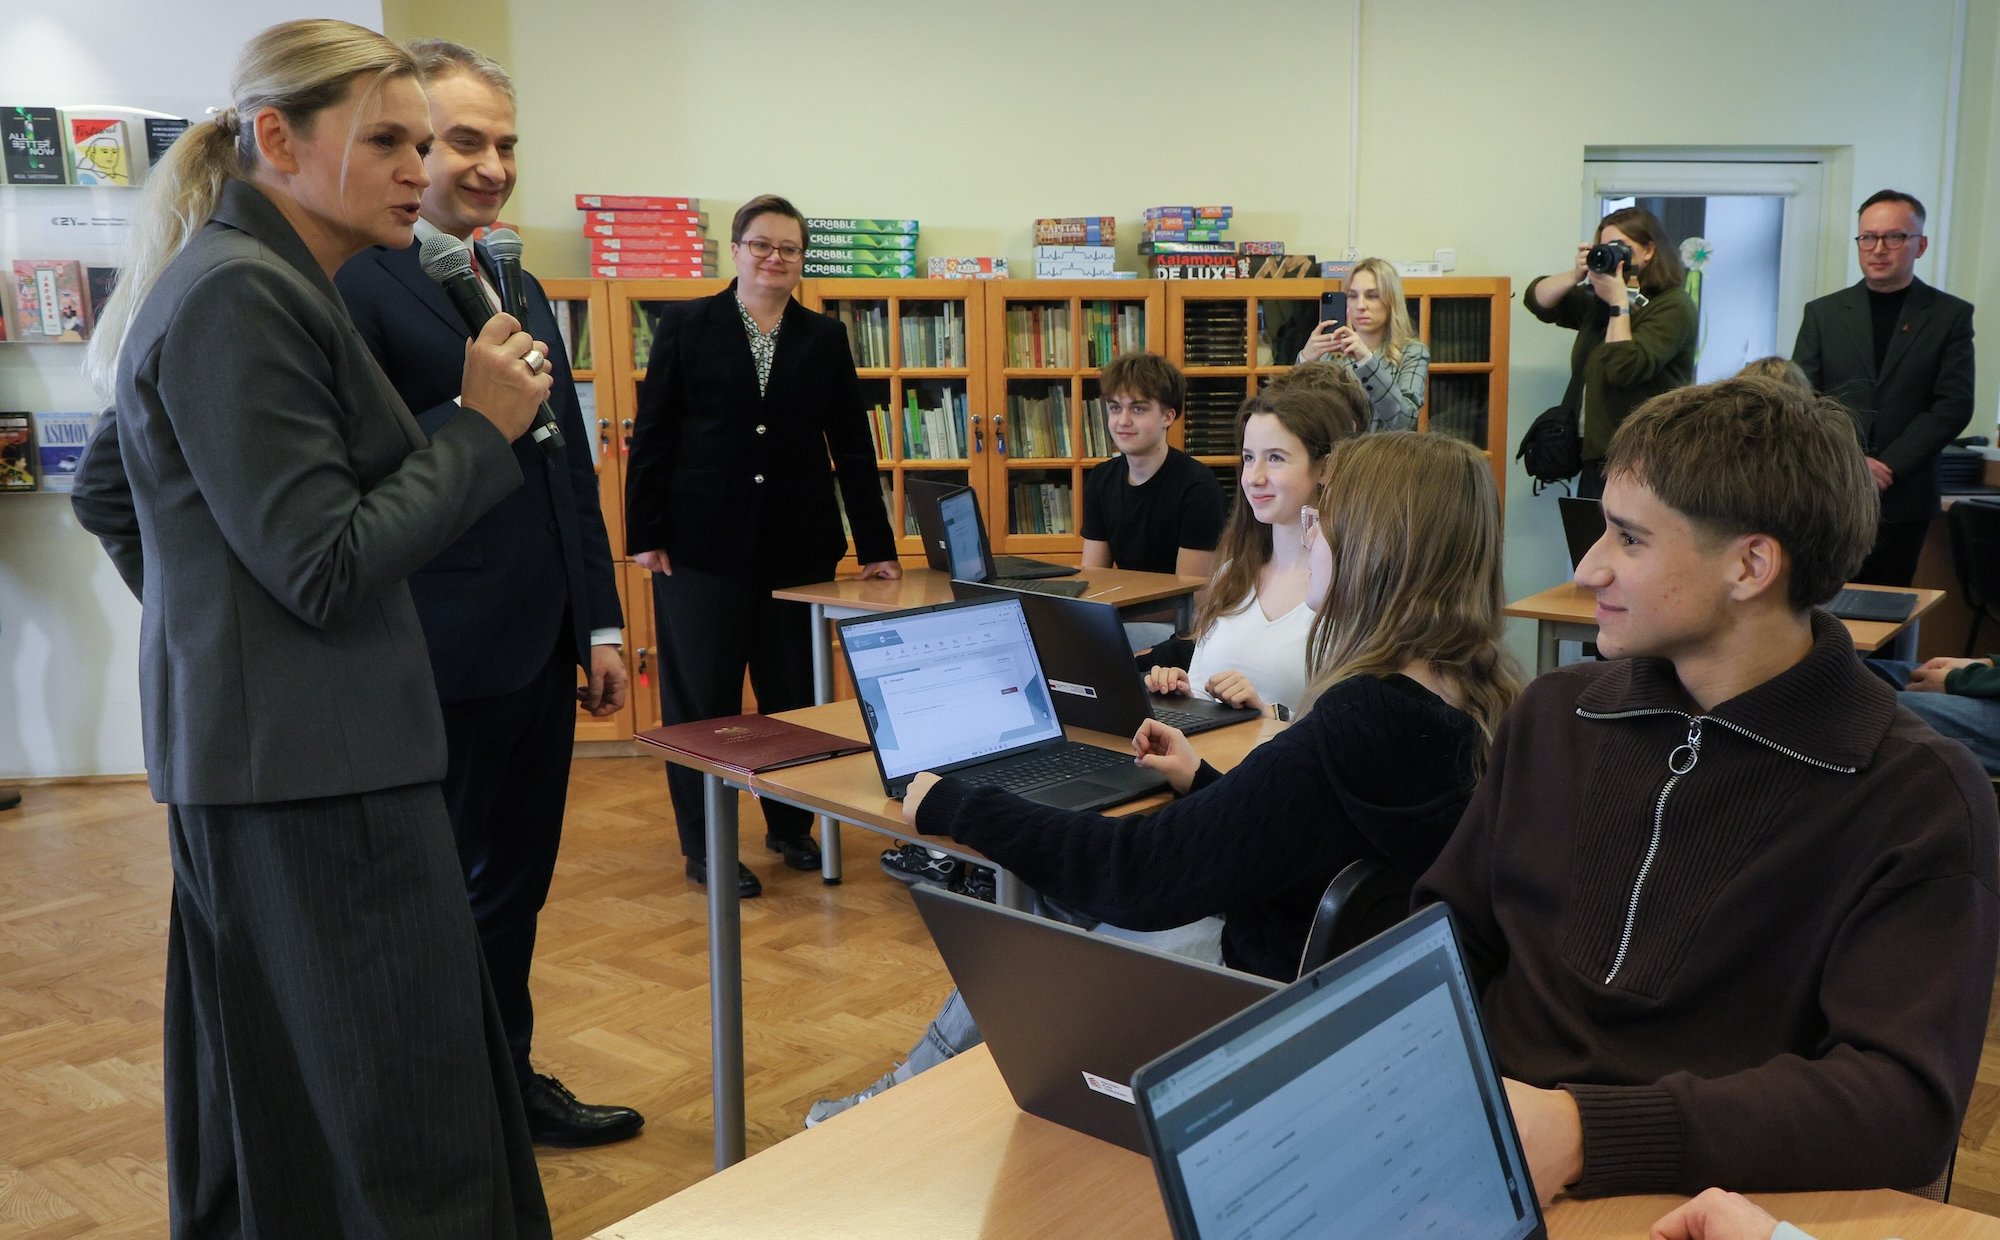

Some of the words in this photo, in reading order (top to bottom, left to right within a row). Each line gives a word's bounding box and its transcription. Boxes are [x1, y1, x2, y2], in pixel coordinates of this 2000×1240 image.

[12, 140, 51, 148] BETTER
[30, 148, 55, 156] NOW
[807, 219, 857, 230] SCRABBLE
[810, 234, 854, 244] CRABBLE
[805, 249, 854, 260] SCRABBLE
[1157, 254, 1237, 267] Kalambury
[804, 264, 854, 275] SCRABBLE
[1158, 267, 1181, 280] DE
[1188, 267, 1236, 280] LUXE
